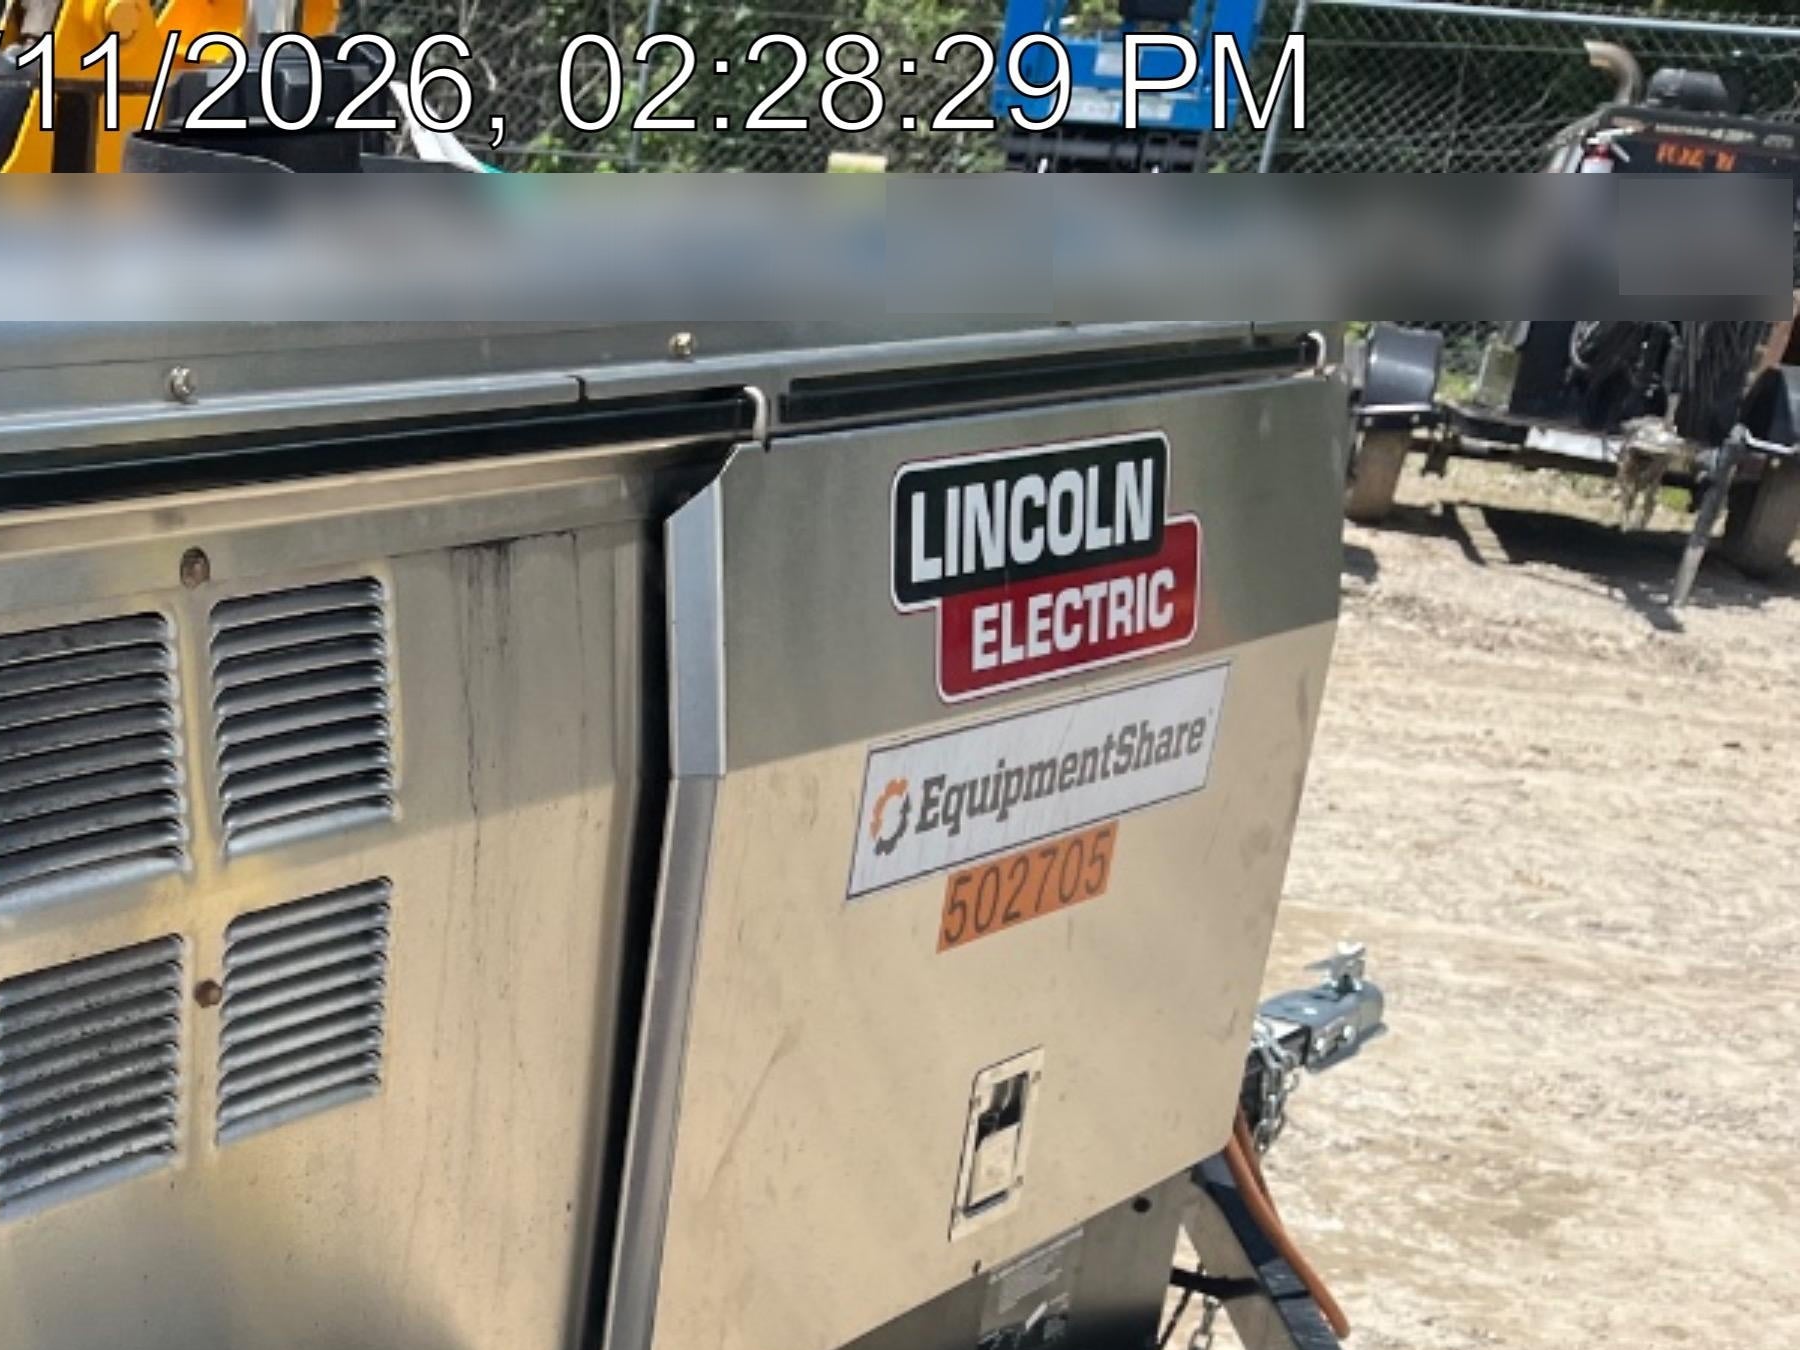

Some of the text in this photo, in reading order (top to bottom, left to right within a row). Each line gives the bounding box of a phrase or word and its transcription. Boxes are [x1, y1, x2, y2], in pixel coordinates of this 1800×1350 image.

[911, 458, 1154, 584] LINCOLN
[971, 568, 1175, 673] ELECTRIC
[914, 716, 1207, 838] EquipmentShare
[943, 829, 1111, 944] 502705
